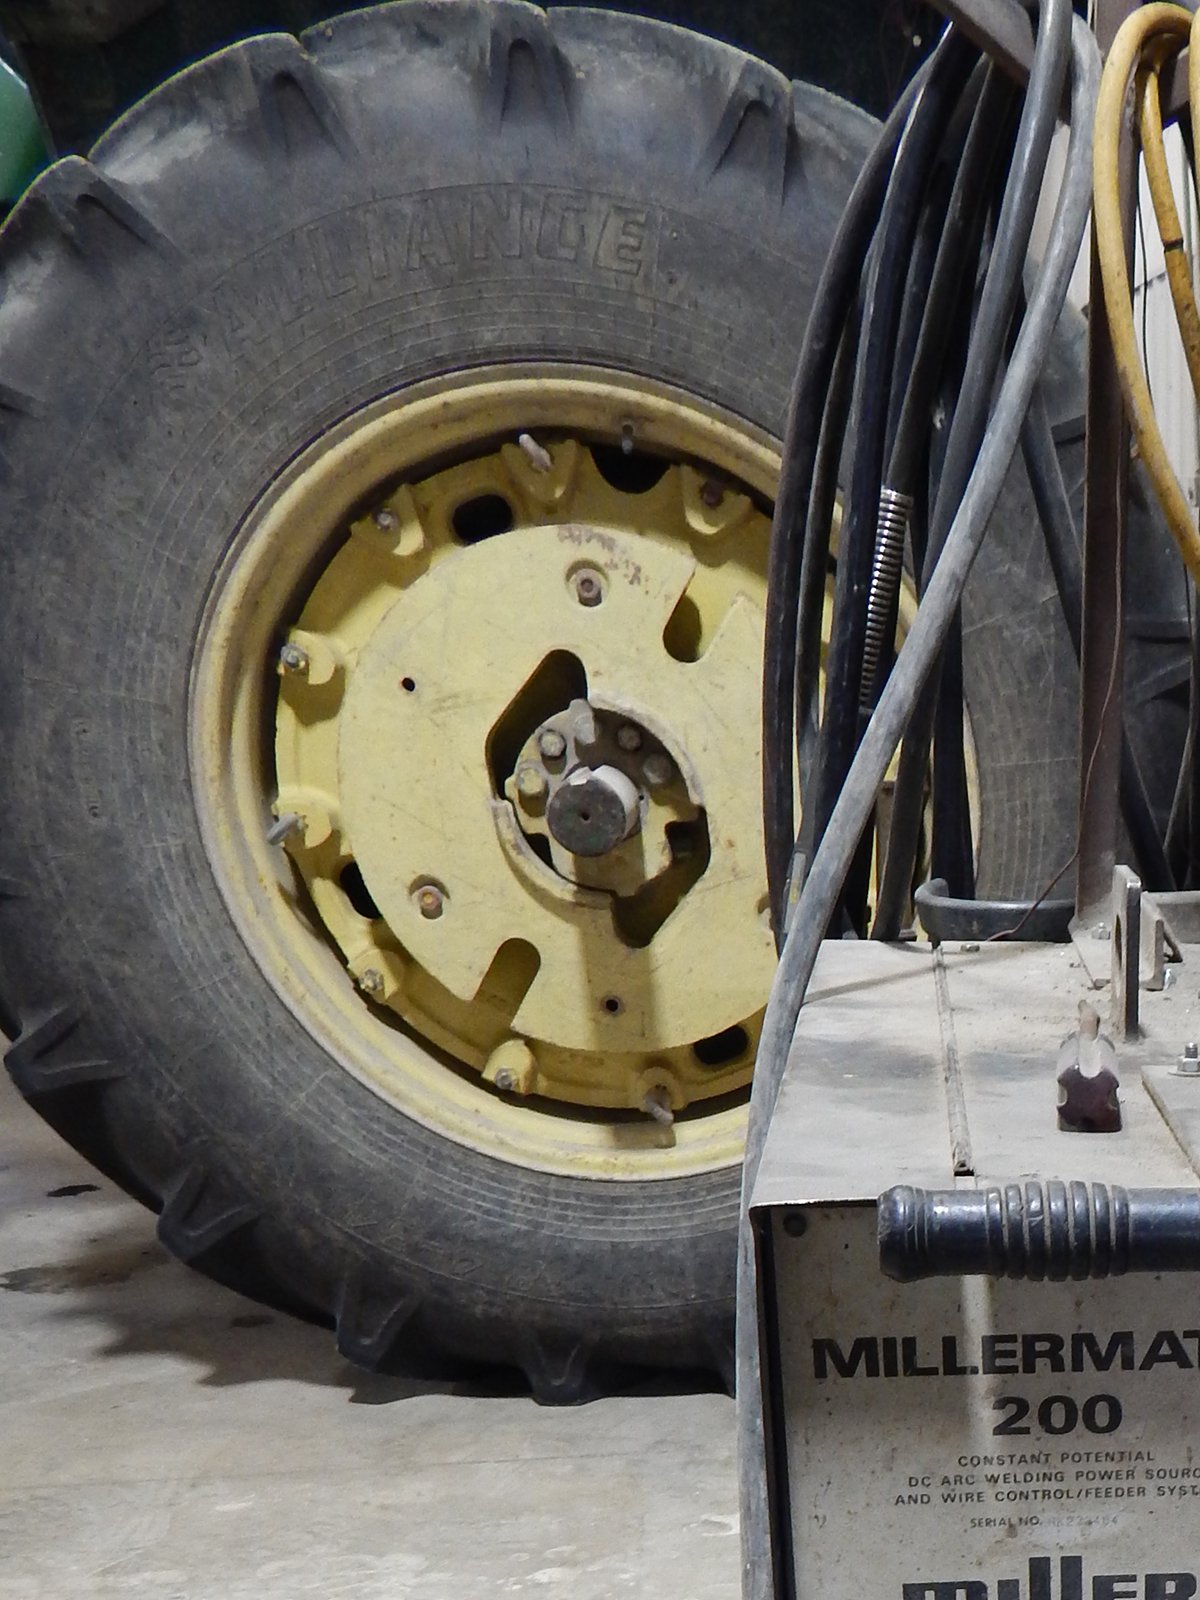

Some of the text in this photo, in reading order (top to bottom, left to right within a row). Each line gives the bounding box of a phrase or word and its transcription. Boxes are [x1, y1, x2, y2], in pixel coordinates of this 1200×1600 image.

[213, 195, 650, 352] ALLIANCE
[992, 1394, 1123, 1436] 200
[958, 1450, 1155, 1468] CONSTANT POTENTIAL
[908, 1476, 932, 1488] DC
[941, 1473, 975, 1486] ARC
[985, 1471, 1065, 1485] WELDING
[1075, 1469, 1136, 1483] POWER
[894, 1493, 931, 1506] AND
[941, 1491, 985, 1504] WIRE
[994, 1486, 1147, 1502] CONTROL/FEEDER
[970, 1517, 1012, 1529] SERIAL
